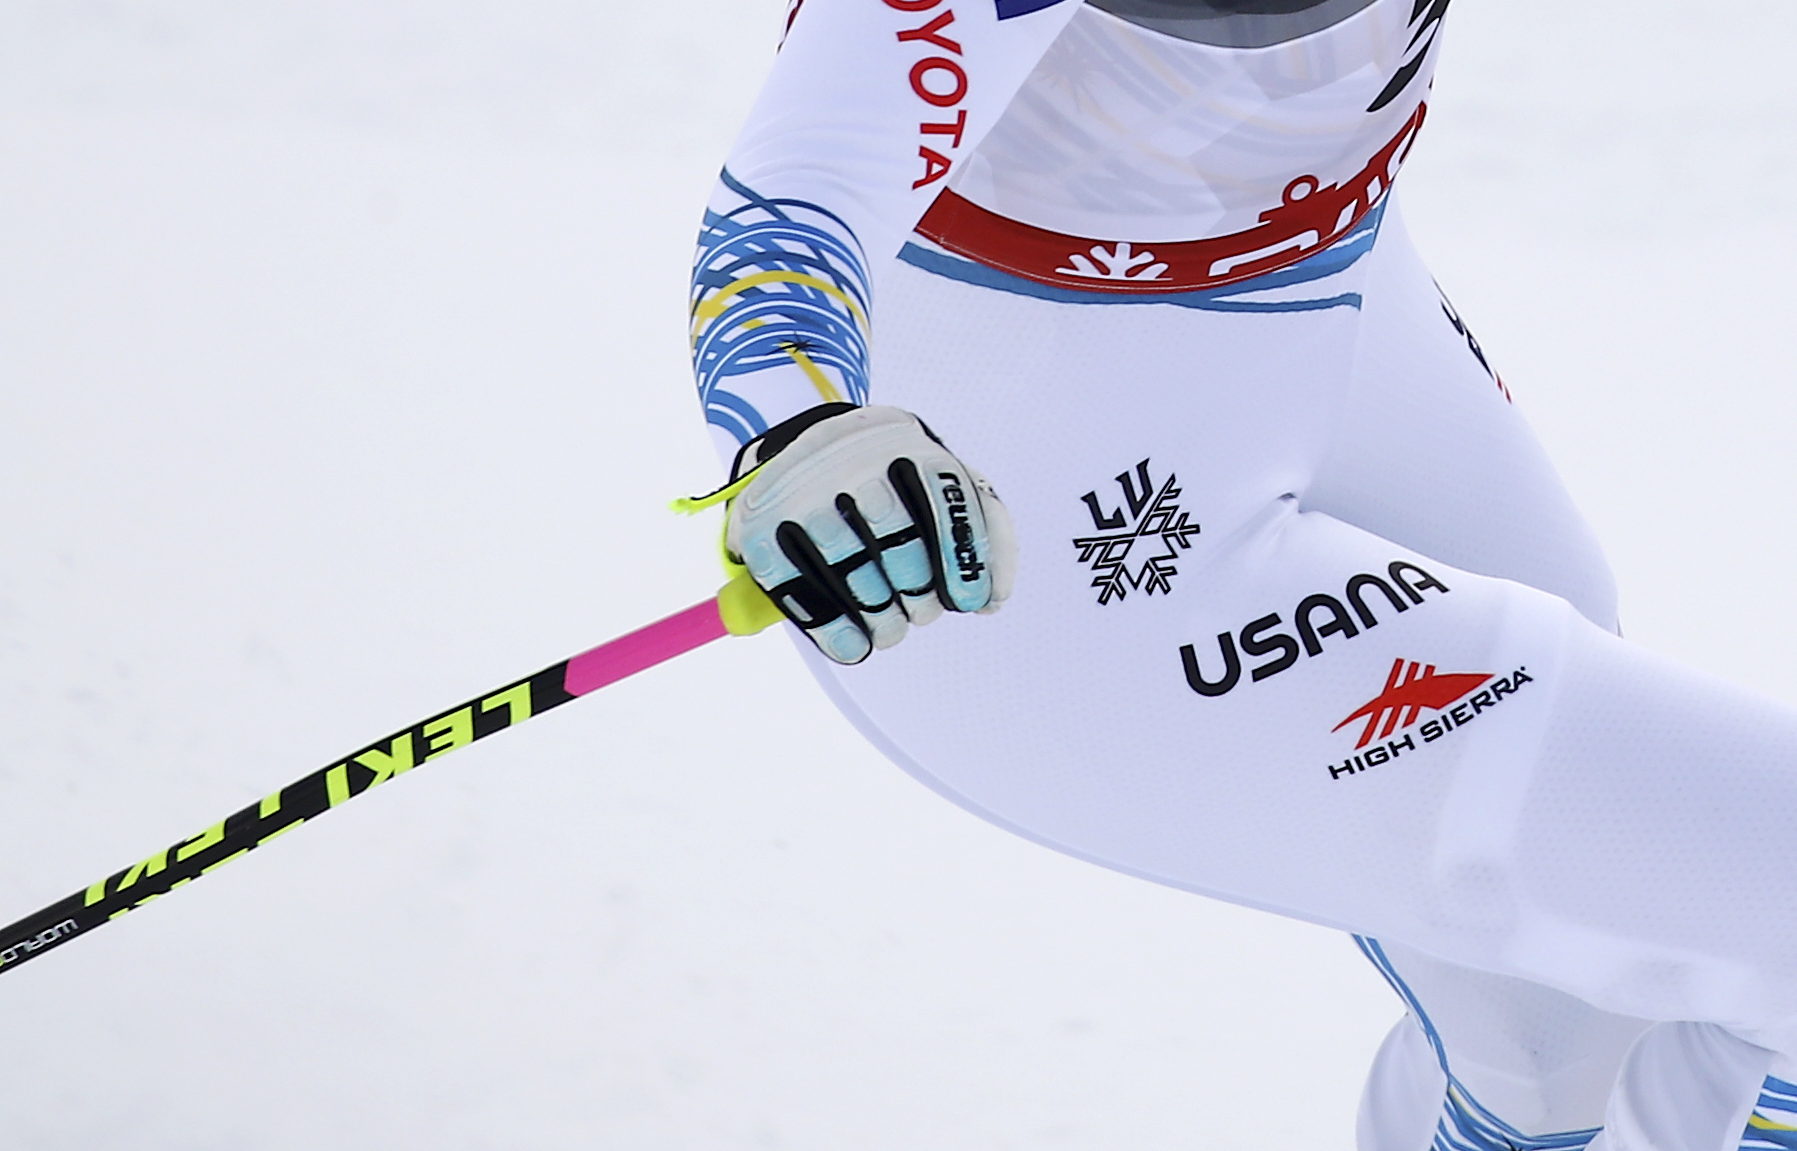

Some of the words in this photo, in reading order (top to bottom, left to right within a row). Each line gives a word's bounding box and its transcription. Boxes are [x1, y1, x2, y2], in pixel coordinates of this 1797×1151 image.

[937, 472, 986, 582] reusch
[1178, 559, 1452, 699] USANA
[324, 680, 533, 809] LEKI
[1327, 728, 1416, 780] HIGH
[1419, 667, 1534, 743] SIERRA
